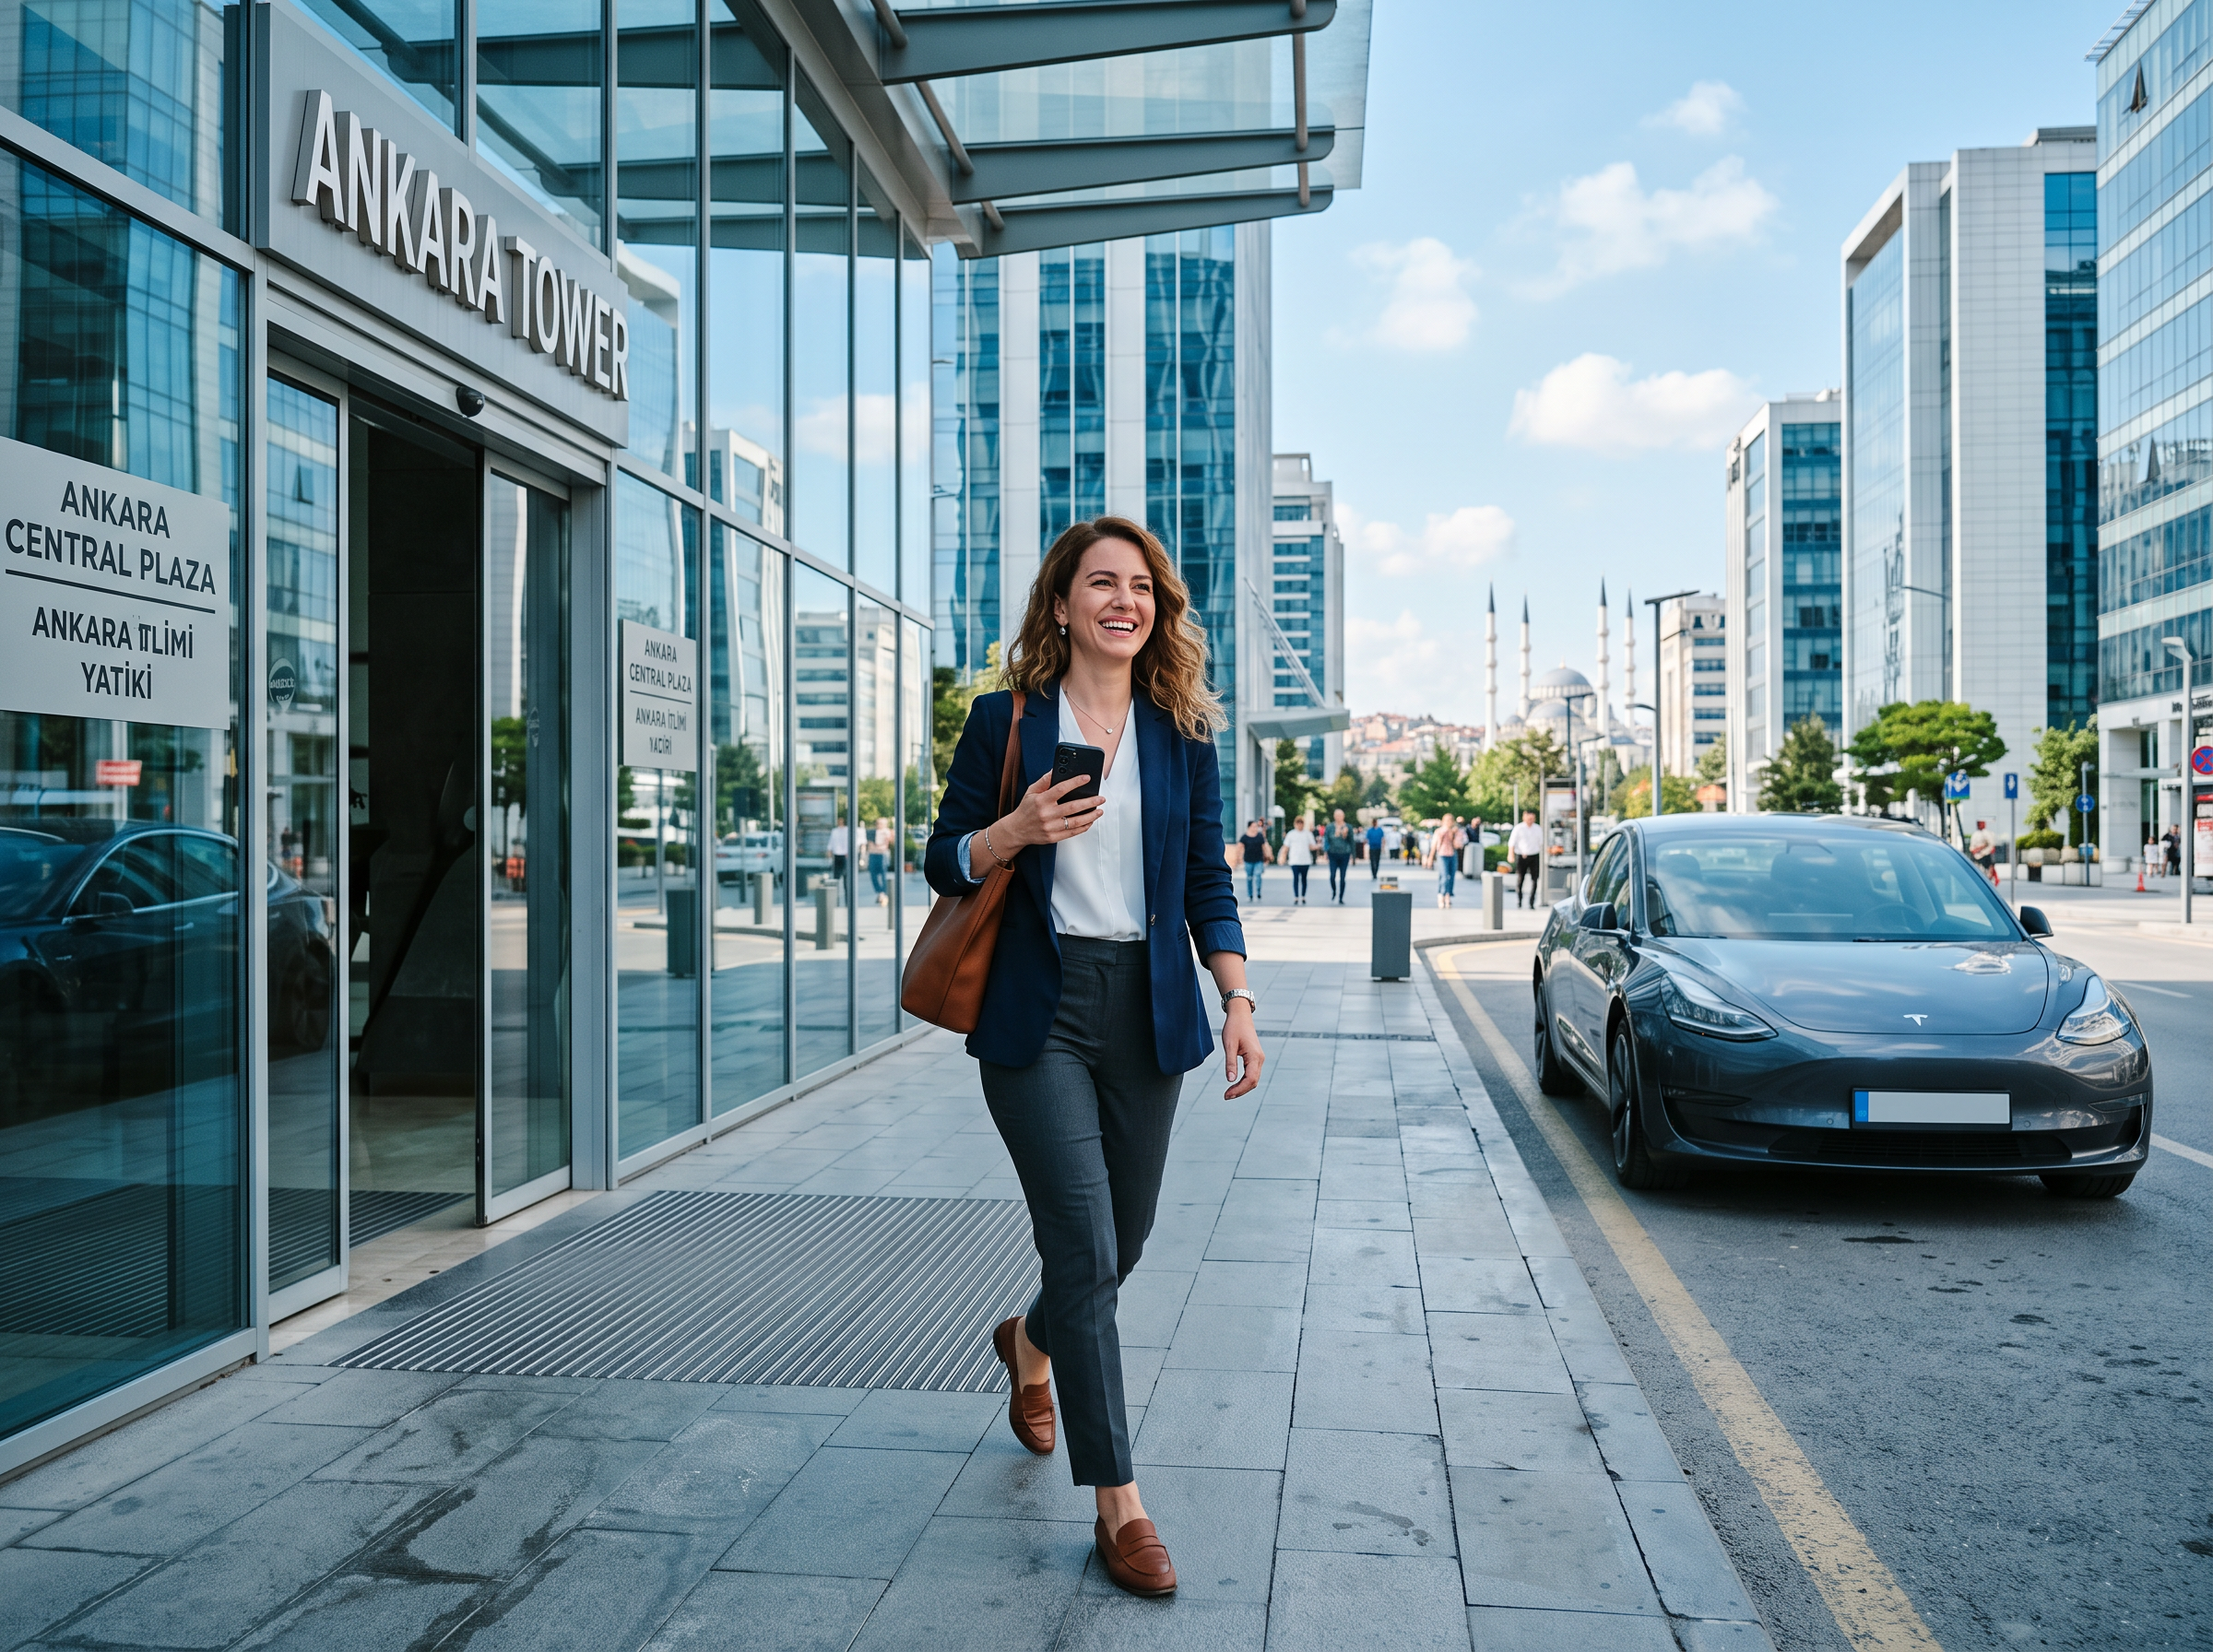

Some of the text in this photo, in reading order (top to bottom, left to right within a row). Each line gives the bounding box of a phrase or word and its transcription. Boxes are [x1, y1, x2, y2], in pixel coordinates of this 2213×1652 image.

[291, 89, 629, 401] ANKARA TOWER
[60, 481, 171, 538] ANKARA
[6, 518, 216, 595] CENTRAL PLAZA
[31, 607, 133, 651] ANKARA
[645, 639, 677, 663] ANKARA
[630, 663, 692, 693] CENTRAL PLAZA
[635, 707, 666, 728] ANKARA
